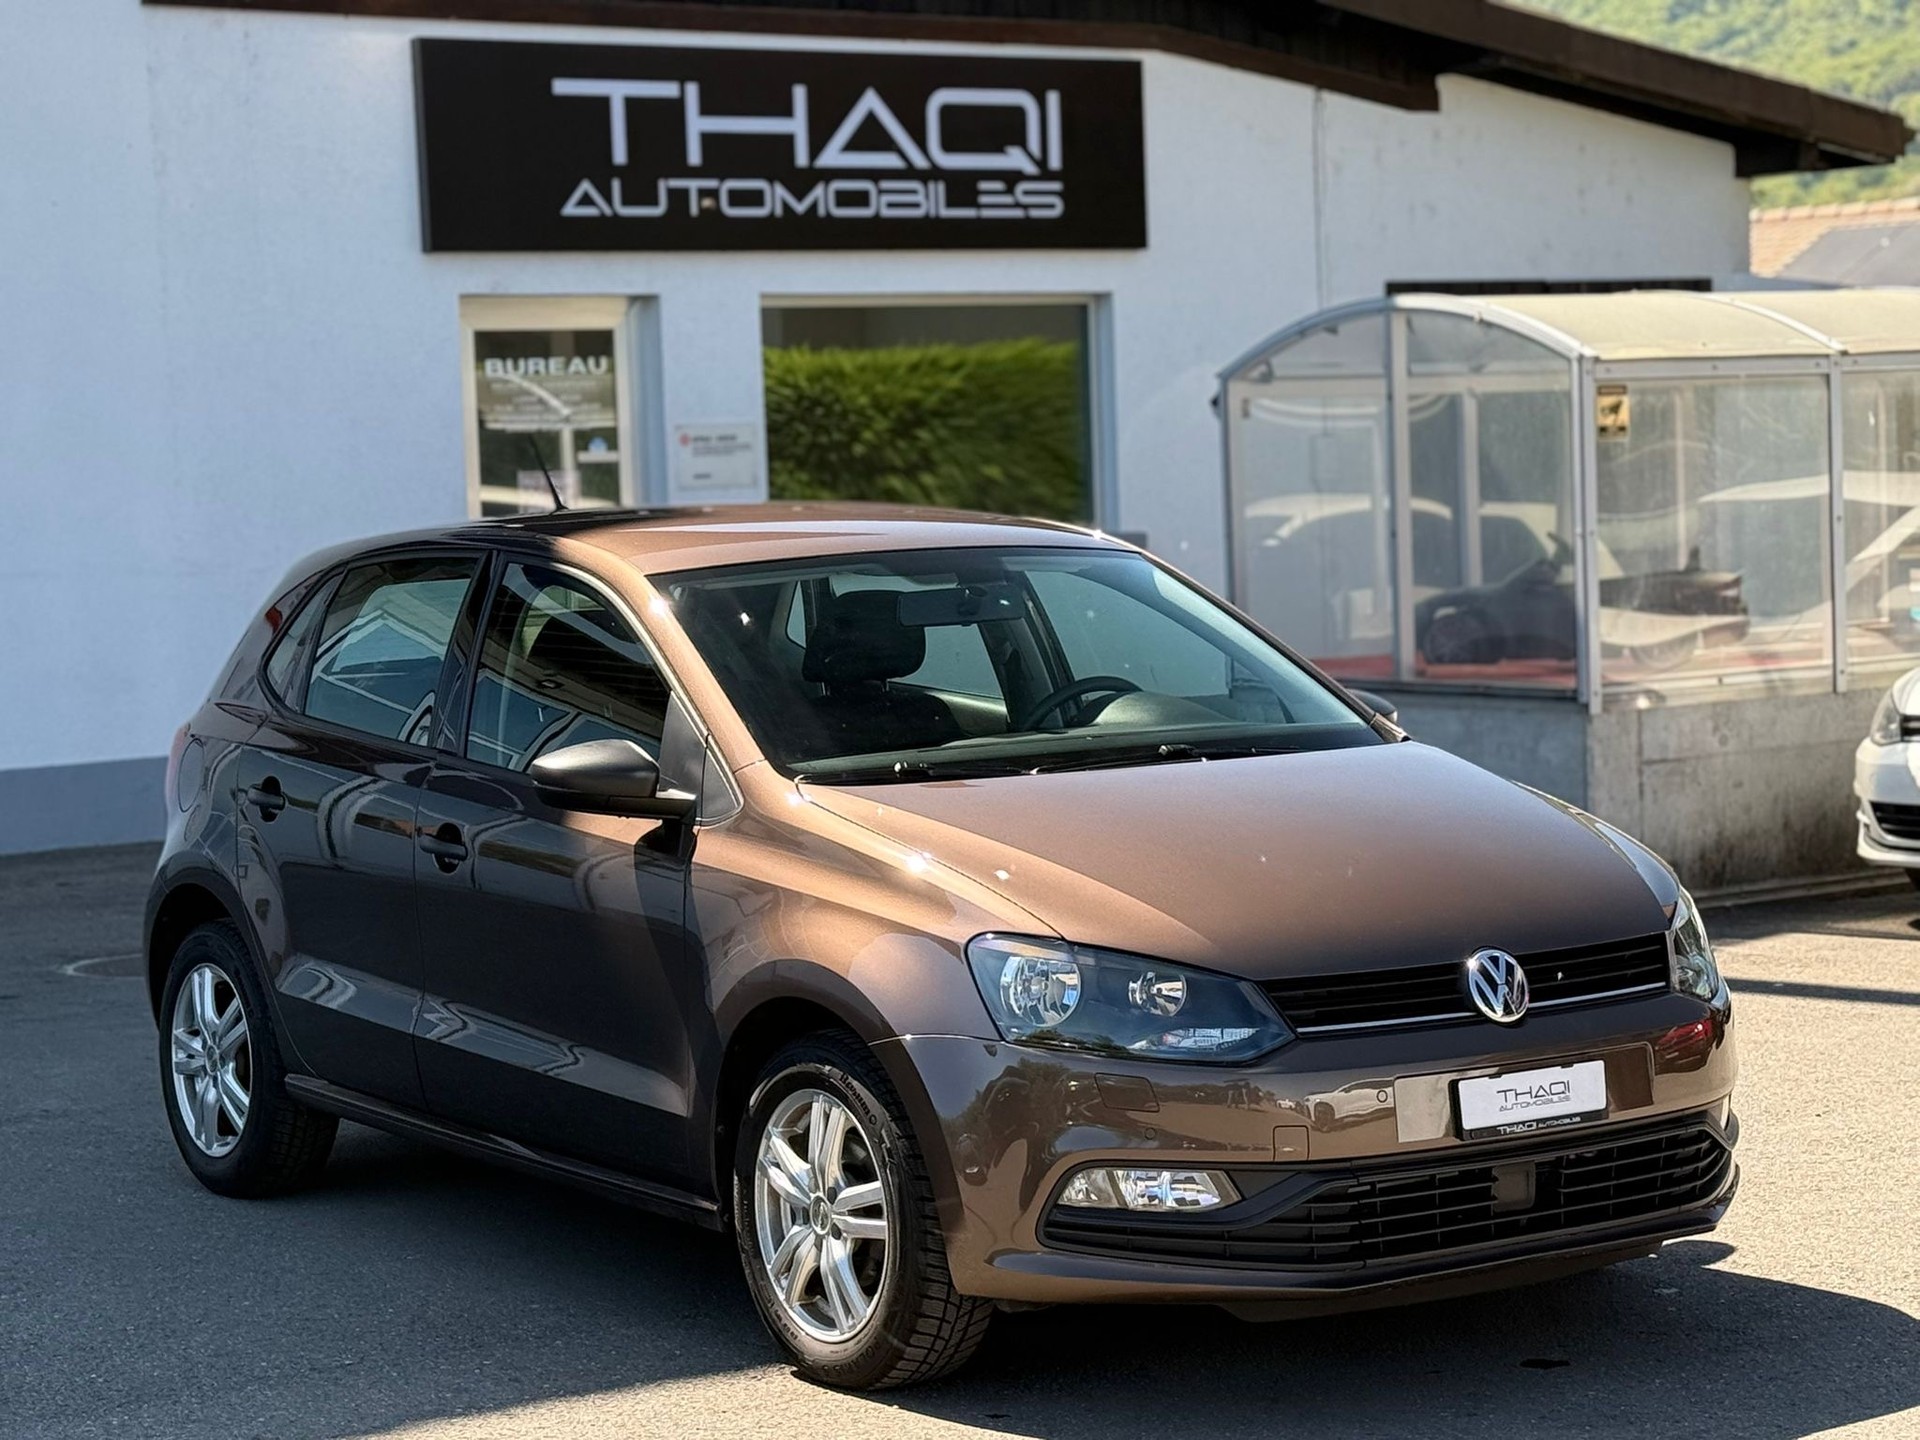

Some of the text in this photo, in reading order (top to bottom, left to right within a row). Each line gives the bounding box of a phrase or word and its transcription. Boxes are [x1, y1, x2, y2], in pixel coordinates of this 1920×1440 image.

[552, 77, 1063, 175] THAQI
[561, 178, 1064, 218] AUTOMOBILES
[484, 355, 608, 379] BUREAU
[1496, 1080, 1571, 1103] THAQI
[1496, 1121, 1537, 1135] THAQI
